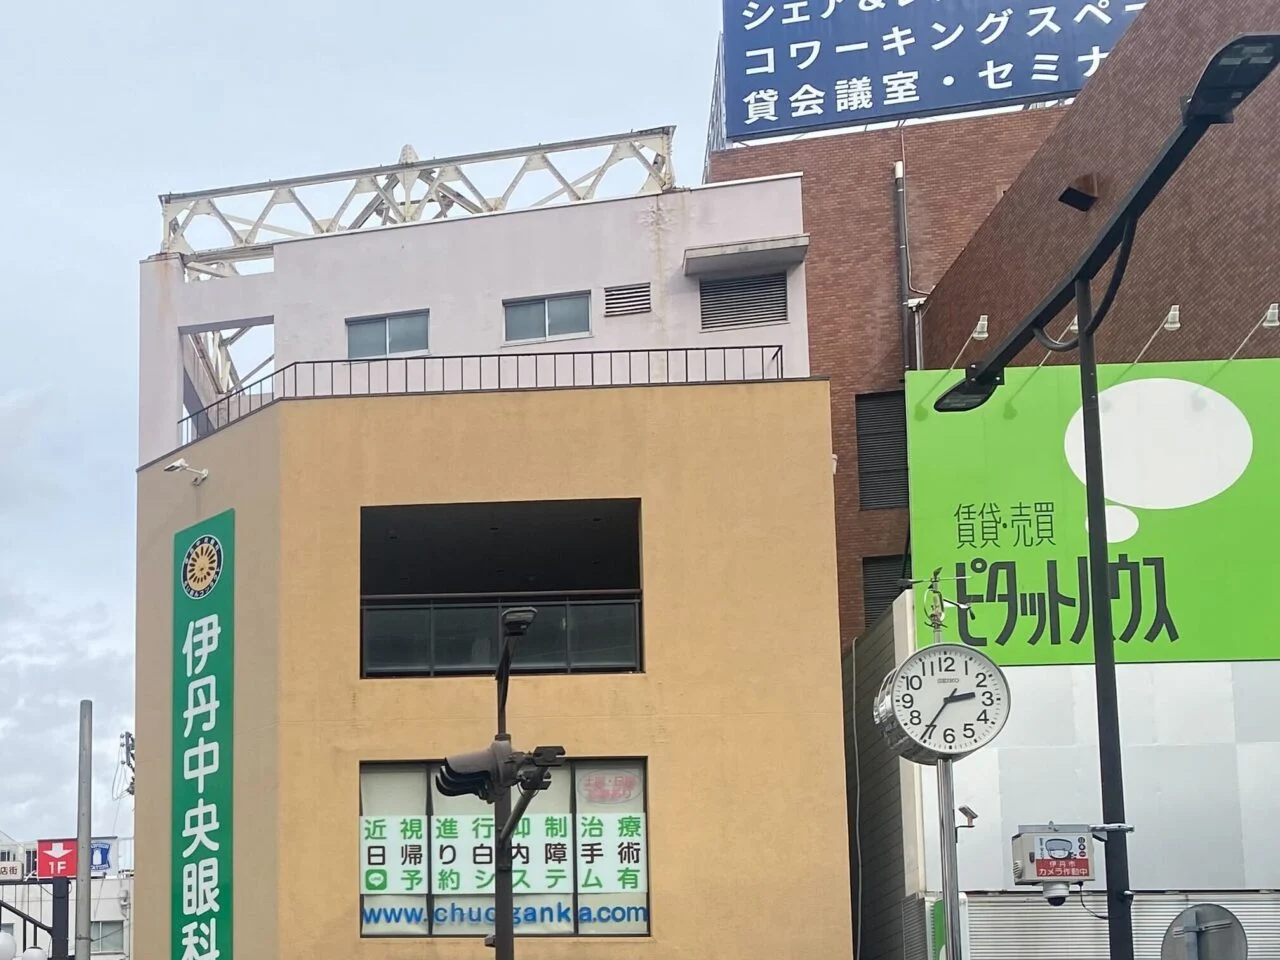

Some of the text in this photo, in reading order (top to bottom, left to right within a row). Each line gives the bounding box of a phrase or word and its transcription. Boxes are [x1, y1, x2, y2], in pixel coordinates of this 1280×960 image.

[954, 501, 1057, 549] 賃貸・売買
[955, 553, 1180, 647] ピタットハウス
[922, 661, 934, 676] 11
[938, 656, 956, 672] 12
[905, 674, 922, 691] 10
[975, 672, 987, 688] 2
[901, 693, 914, 709] 9
[981, 691, 994, 707] 3
[909, 709, 922, 725] 8
[976, 709, 989, 724] 4
[943, 728, 956, 743] 6
[963, 723, 975, 738] 5
[367, 842, 641, 865] 日帰り白内障手術
[48, 861, 67, 874] 1F
[1039, 868, 1088, 876] カメラ作動中
[1049, 860, 1076, 868] 伊丹市
[401, 867, 641, 891] 予約システム有
